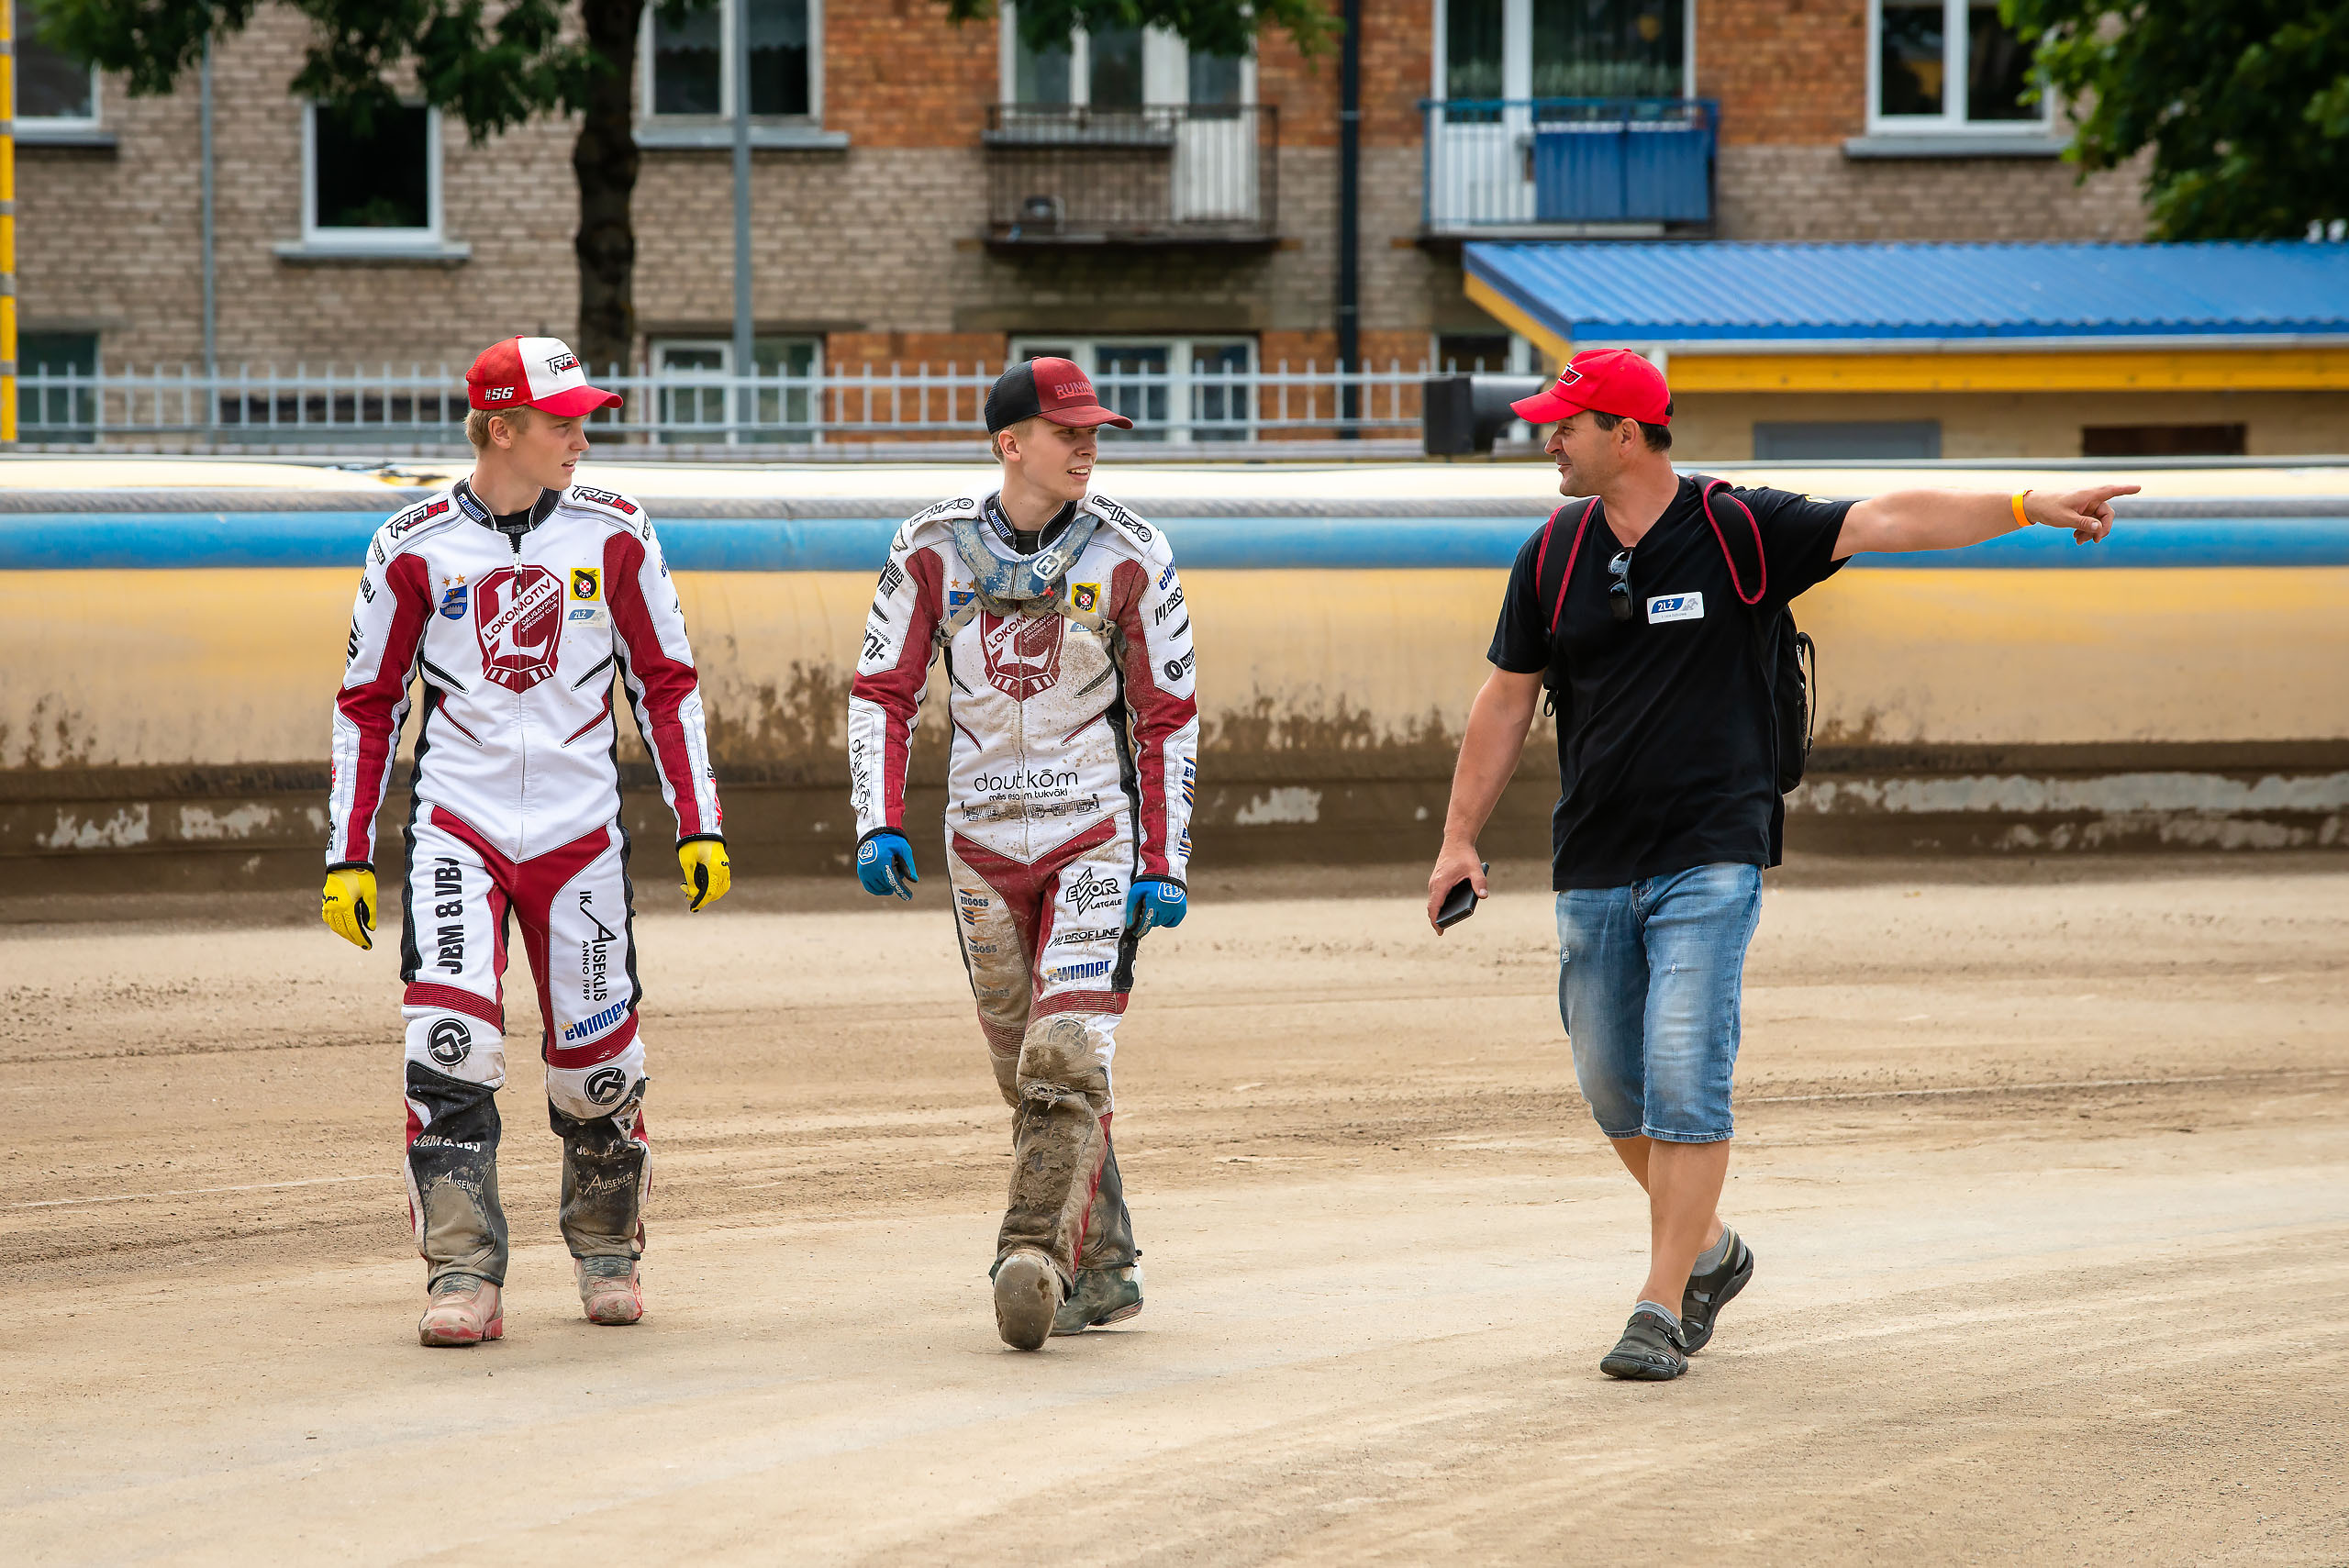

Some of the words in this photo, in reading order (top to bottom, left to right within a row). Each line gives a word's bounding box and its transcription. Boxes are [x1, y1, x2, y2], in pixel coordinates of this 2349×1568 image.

[484, 386, 514, 401] #56
[484, 578, 551, 641] LOKOMOTIV
[521, 595, 558, 626] DAUGAVPILS
[545, 604, 558, 615] CLUB
[988, 613, 1031, 650] LOKOM
[1047, 616, 1059, 627] CLUB
[434, 857, 462, 897] VBJ
[435, 899, 464, 918] &
[579, 891, 592, 904] IK
[961, 895, 989, 907] ERGOSS
[1091, 898, 1122, 910] LATGALE
[436, 925, 464, 975] JBM
[580, 906, 618, 1002] AUSEKLIS
[582, 940, 590, 974] ANNO
[582, 979, 590, 1001] 1989
[564, 997, 629, 1041] eWinner
[413, 1135, 442, 1148] JBM
